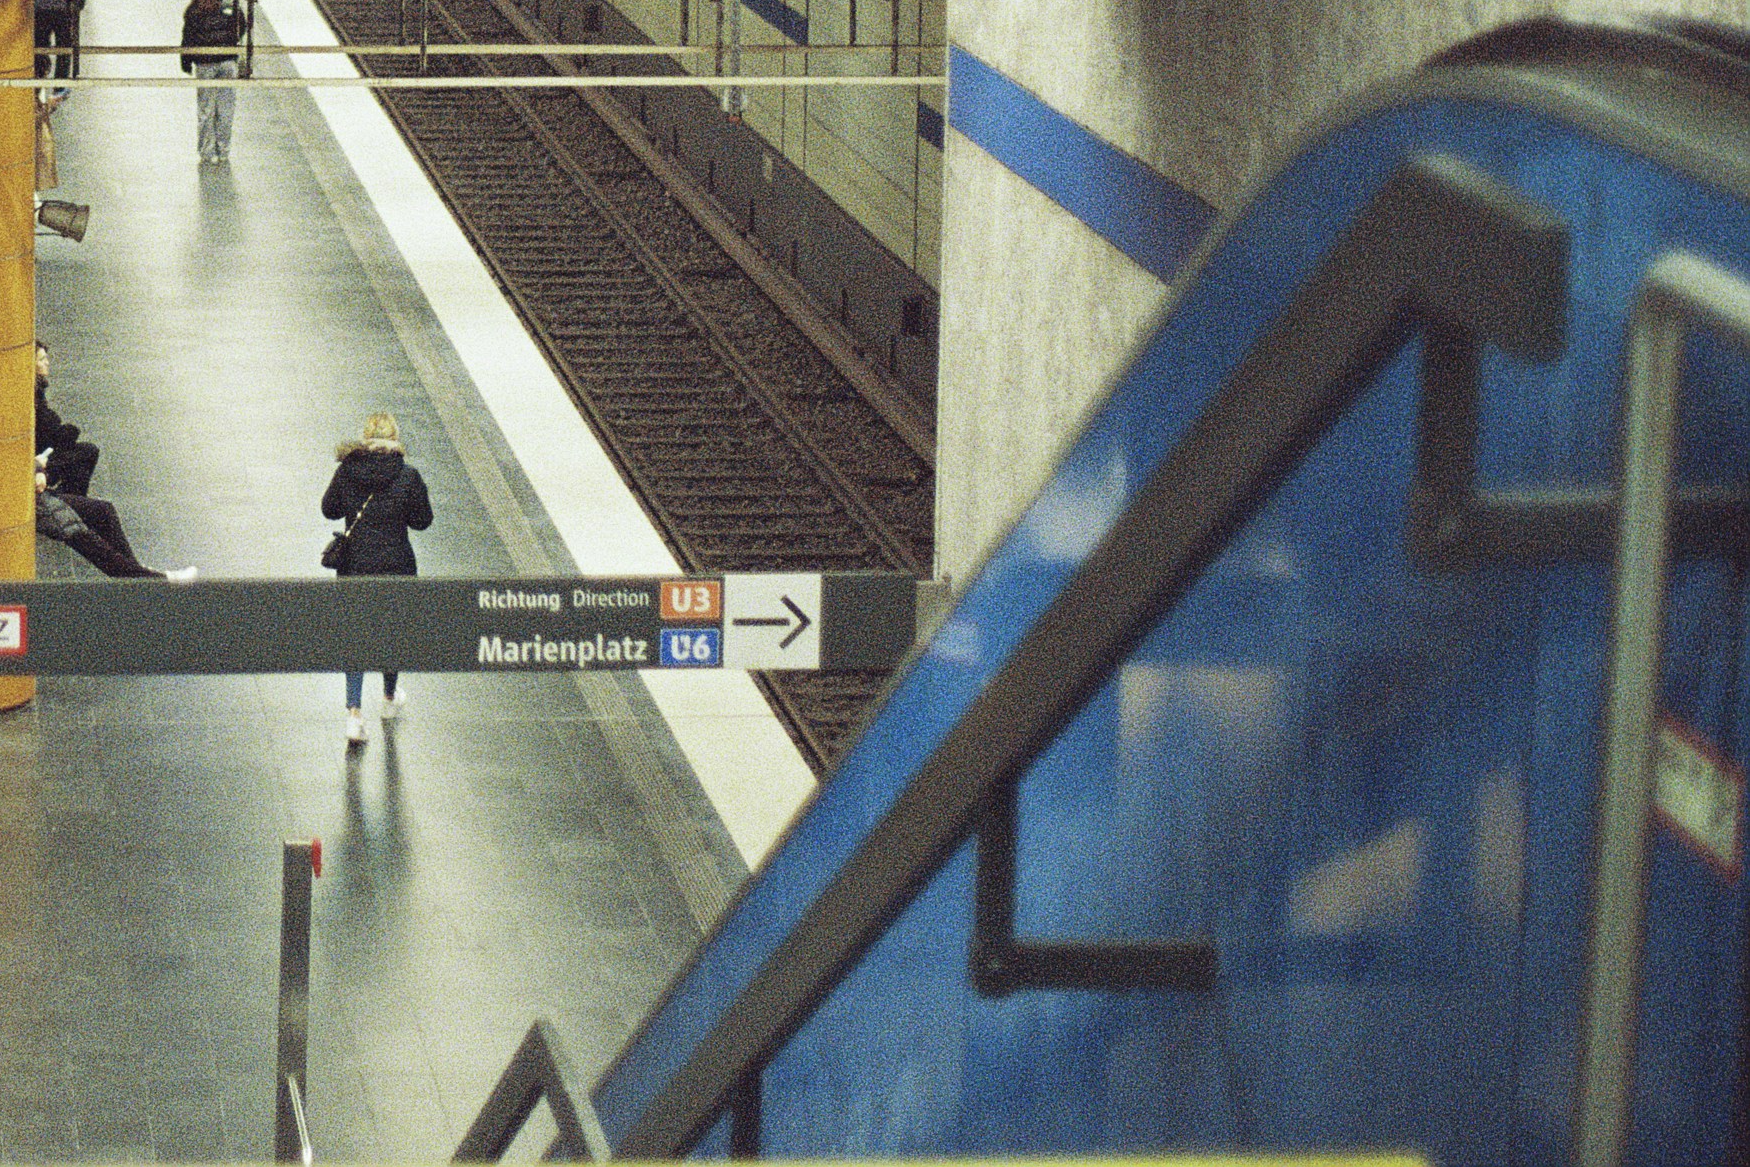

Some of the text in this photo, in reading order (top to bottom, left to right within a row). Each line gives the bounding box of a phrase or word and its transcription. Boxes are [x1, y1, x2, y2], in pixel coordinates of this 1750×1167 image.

[478, 589, 650, 612] Richtung Direction
[671, 587, 711, 614] U3
[478, 633, 648, 667] Marienplatz
[671, 634, 711, 661] U6
